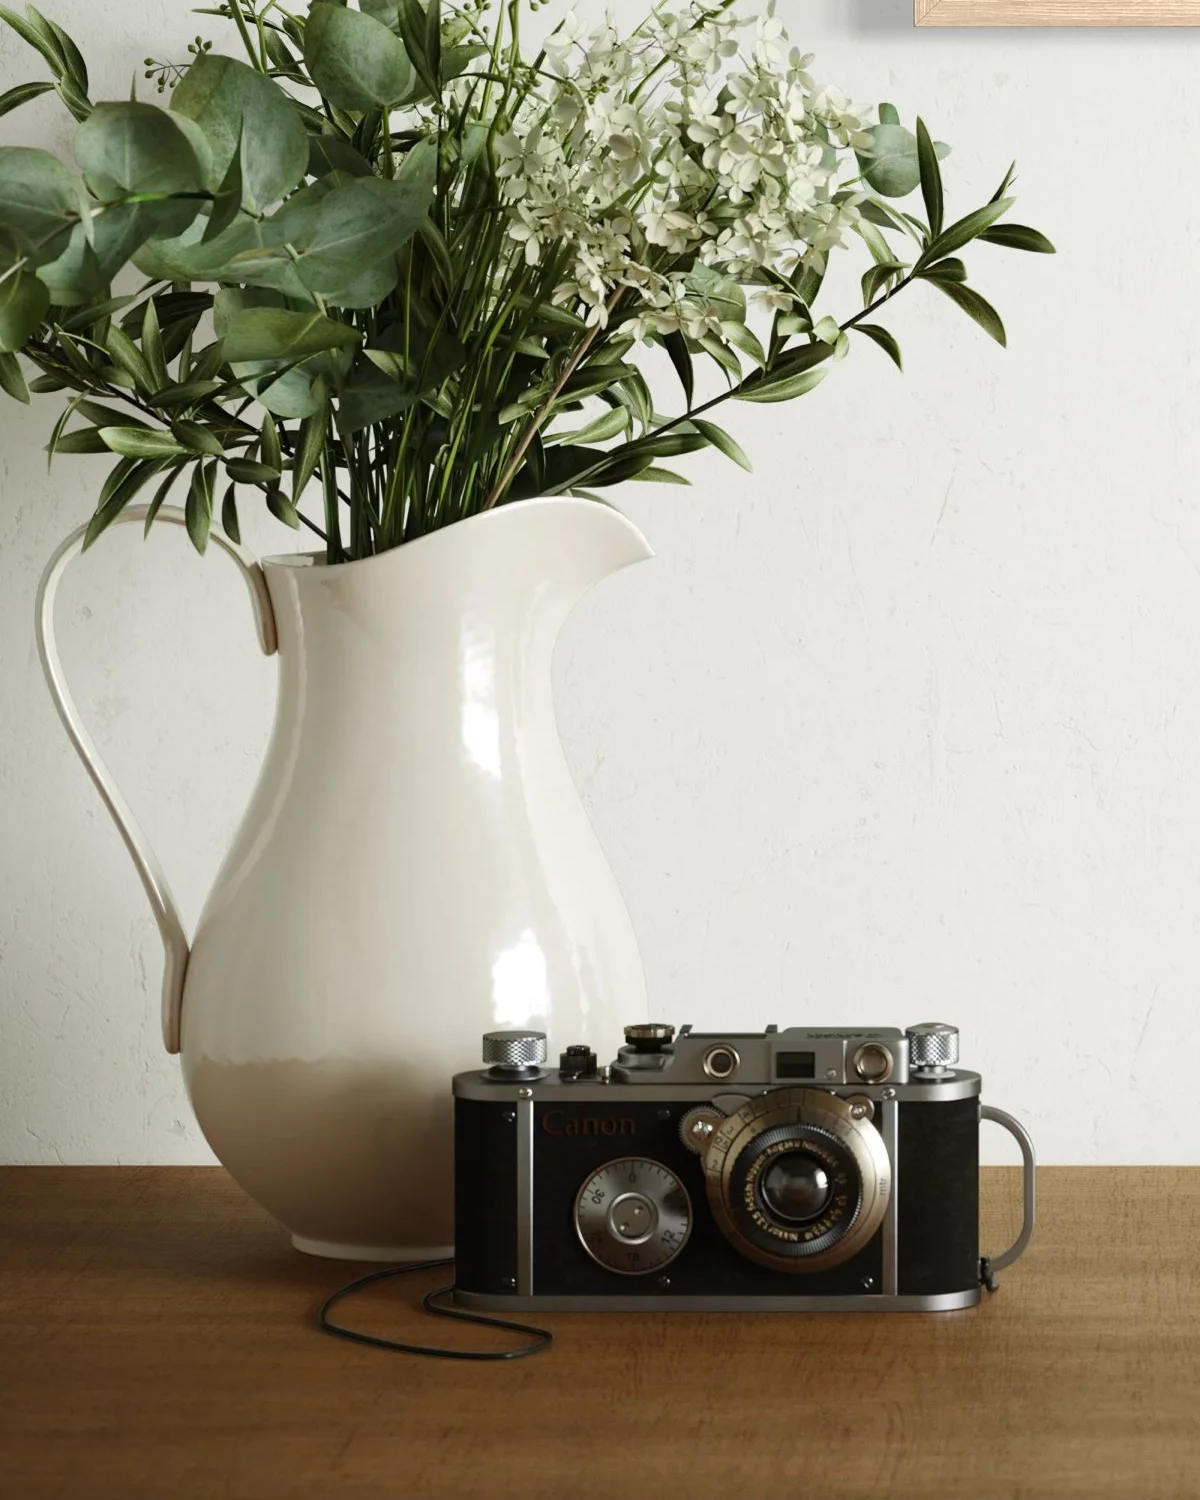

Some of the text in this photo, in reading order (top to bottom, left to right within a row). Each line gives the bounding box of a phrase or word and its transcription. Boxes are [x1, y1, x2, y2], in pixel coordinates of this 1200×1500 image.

[541, 1110, 636, 1136] Canon
[591, 1189, 605, 1205] 30
[660, 1229, 676, 1244] 12
